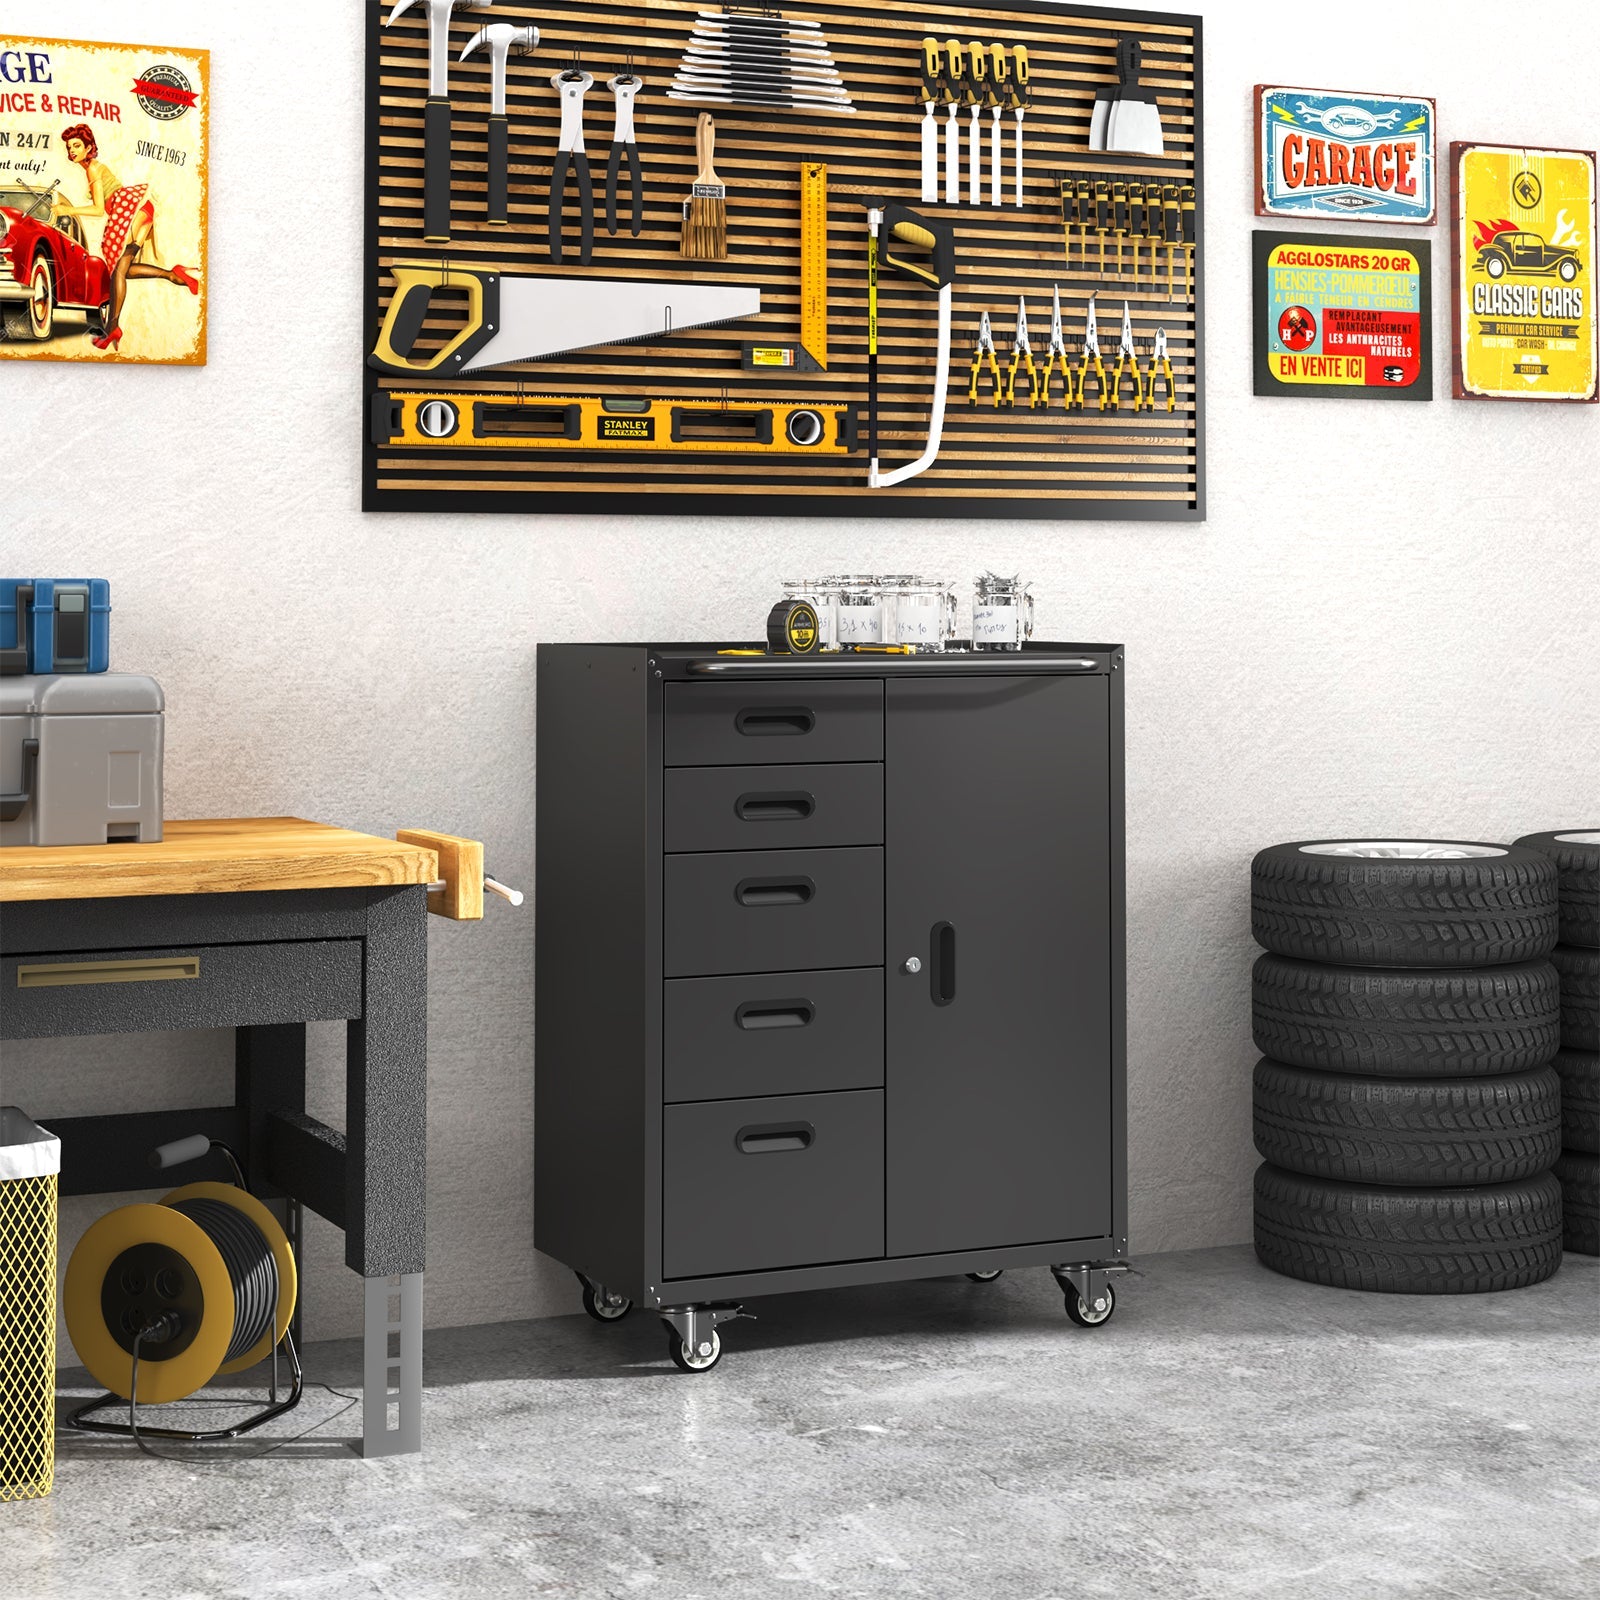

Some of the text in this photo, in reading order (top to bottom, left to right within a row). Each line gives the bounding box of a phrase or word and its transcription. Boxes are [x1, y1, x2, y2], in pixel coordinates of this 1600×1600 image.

[0, 51, 52, 83] GE
[153, 75, 179, 87] PREMIUM
[140, 85, 189, 102] GUARANTEED
[41, 93, 53, 112] &
[57, 95, 122, 123] REPAIR
[149, 99, 173, 111] QUALITY
[17, 133, 50, 149] 24/7
[136, 140, 187, 167] SINCE 1963
[14, 160, 46, 174] only!
[1282, 133, 1416, 197] GARAGE
[1277, 251, 1410, 271] AGGLOSTARS 20 GR
[1286, 294, 1314, 305] FAIBLE
[1319, 295, 1352, 307] TENEUR
[1358, 297, 1370, 307] EN
[1375, 298, 1414, 309] CENDRES
[1473, 282, 1583, 320] CLASSIC CARS
[1282, 328, 1315, 342] H P
[1336, 322, 1412, 334] AVANTAGEUSEMENT
[1495, 323, 1563, 337] PREMIUM CAR SERVICE
[1329, 333, 1402, 346] LES ANTHRACITES
[1517, 338, 1528, 349] CAR
[1529, 339, 1545, 350] WASH
[1370, 346, 1413, 357] NATURELS
[1280, 356, 1362, 378] EN VENTE ICI
[604, 420, 648, 430] STANLEY
